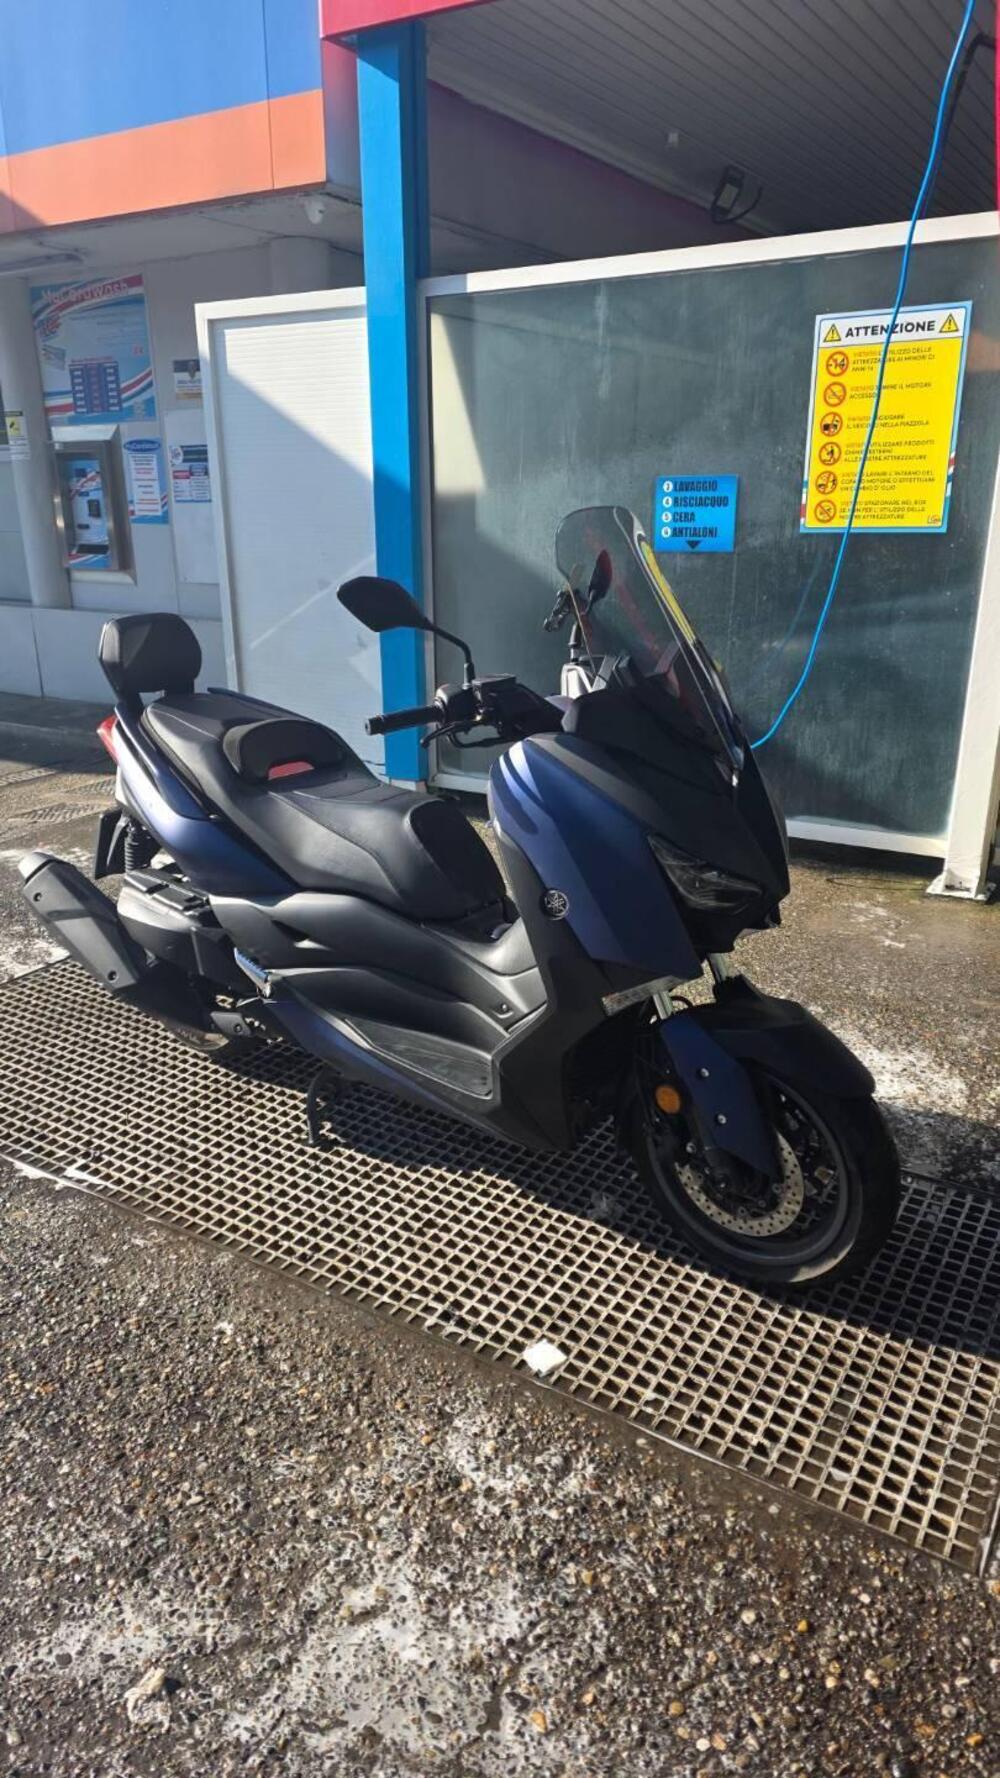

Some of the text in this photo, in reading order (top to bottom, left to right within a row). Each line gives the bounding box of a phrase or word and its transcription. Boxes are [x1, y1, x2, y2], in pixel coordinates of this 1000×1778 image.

[845, 320, 935, 338] ATTENZIONE
[674, 480, 718, 492] LAVAGGIO
[673, 496, 729, 507] RISCIACQUO
[673, 512, 696, 523] CERA
[672, 526, 718, 538] ANTIALONI
